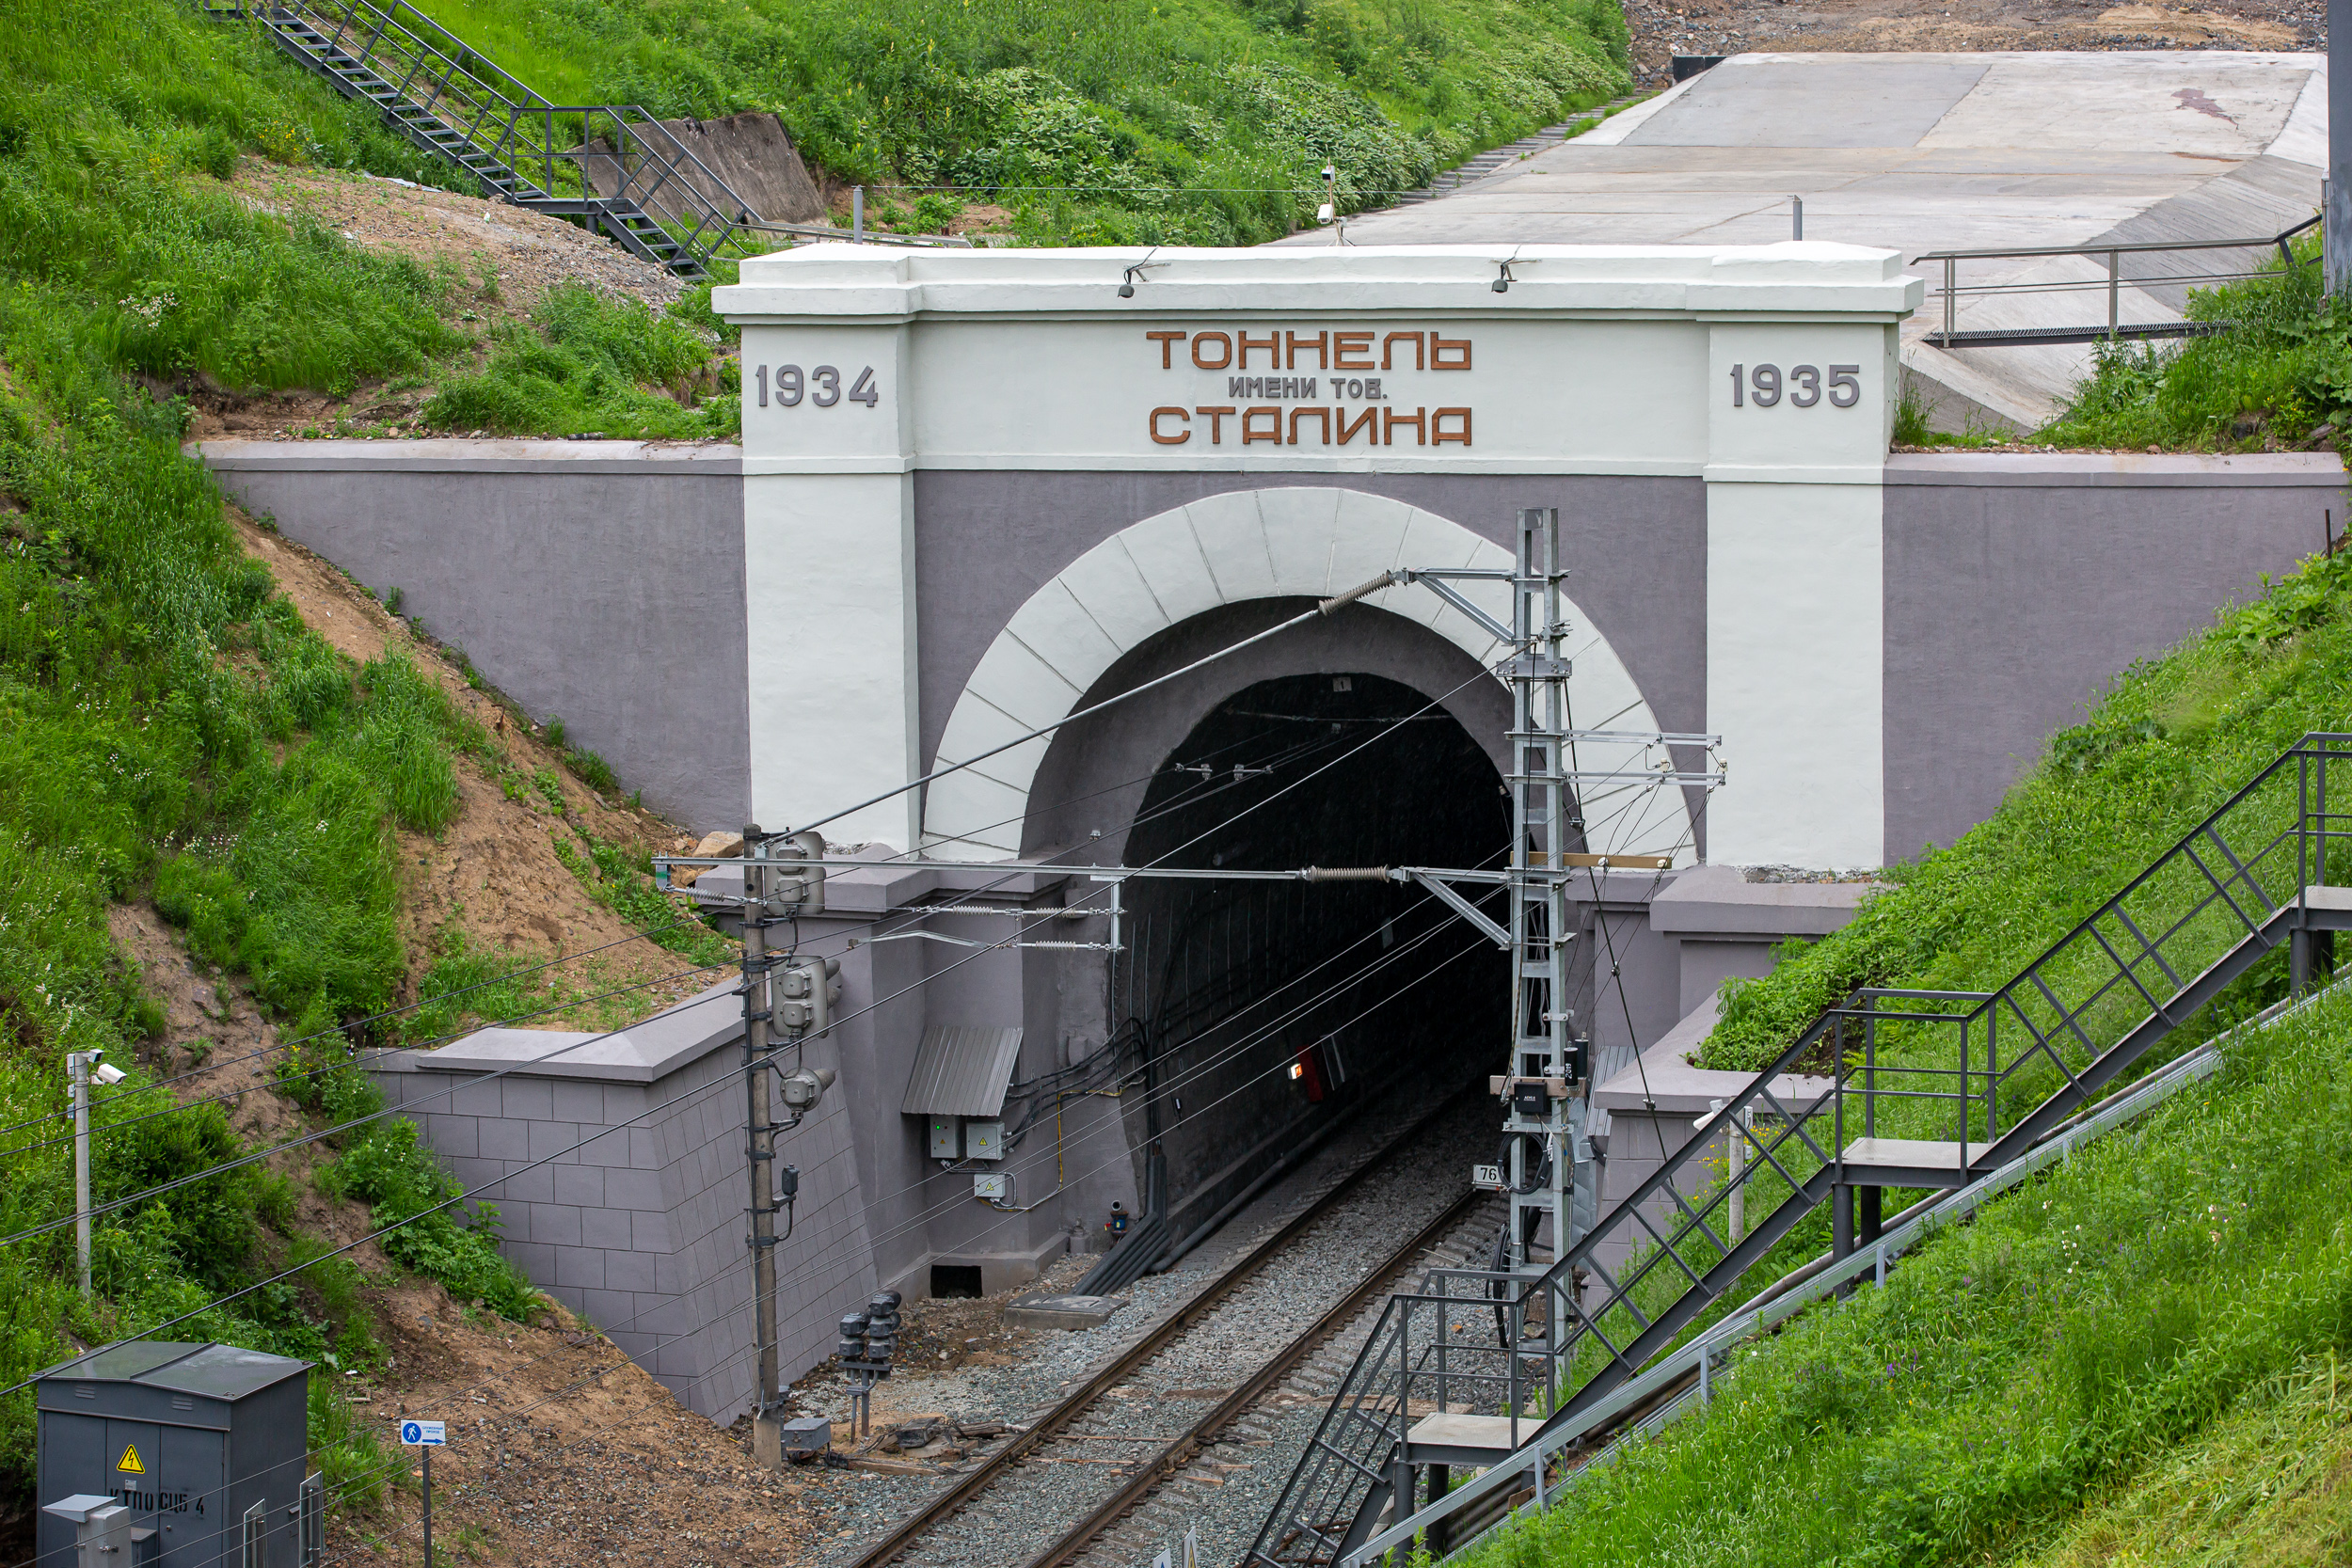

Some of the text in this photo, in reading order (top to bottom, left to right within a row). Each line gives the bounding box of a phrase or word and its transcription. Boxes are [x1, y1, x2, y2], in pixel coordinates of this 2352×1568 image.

[1146, 330, 1471, 370] ТОННЕЛЬ
[755, 364, 879, 407] 1934
[1229, 376, 1388, 400] ИМЕНИ ТОВ.
[1730, 363, 1860, 407] 1935
[1149, 406, 1471, 446] СТАЛИНА
[1565, 1062, 1573, 1080] 2019
[1480, 1166, 1497, 1180] 76
[196, 1497, 204, 1514] 4
